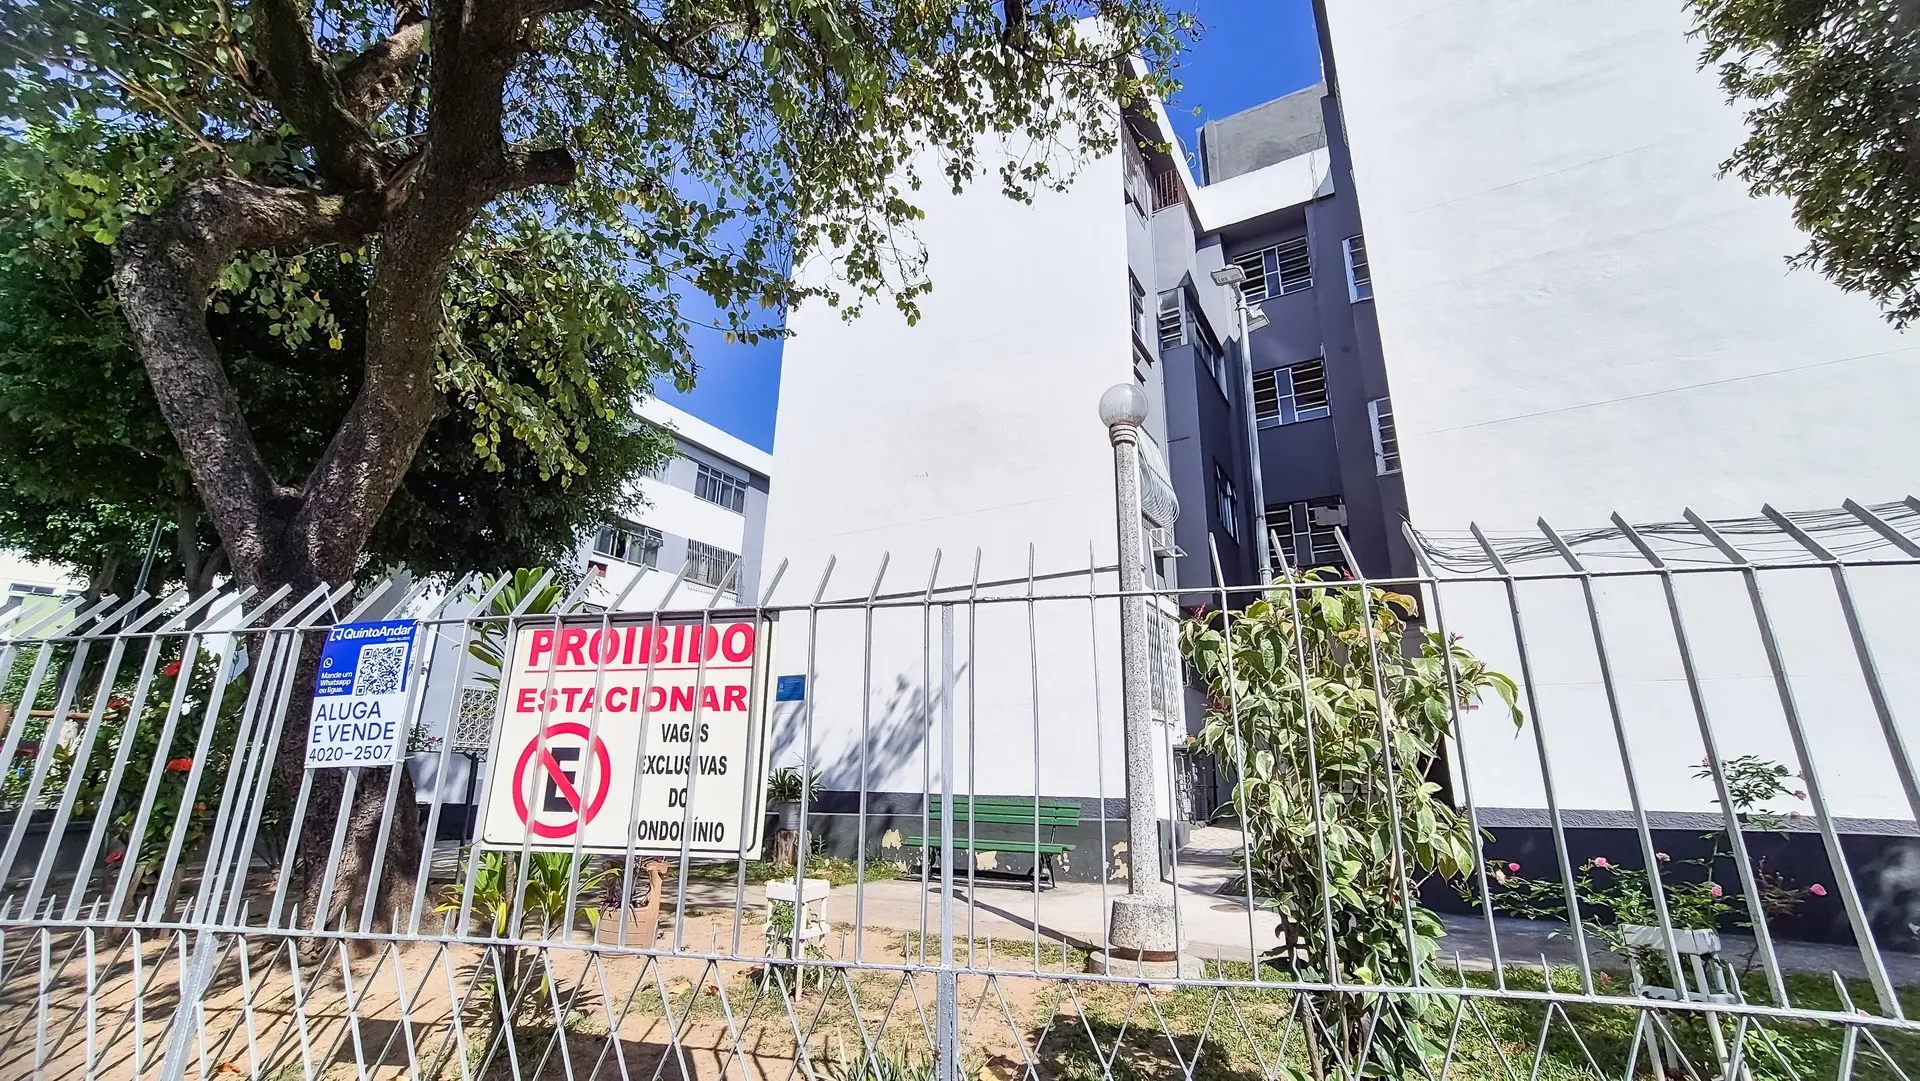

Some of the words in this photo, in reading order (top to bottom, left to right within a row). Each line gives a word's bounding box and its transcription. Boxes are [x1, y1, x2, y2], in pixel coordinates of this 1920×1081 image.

[343, 625, 414, 640] QuintoAndar
[529, 623, 755, 667] PROIBIDO
[320, 679, 351, 687] Whatsapp
[516, 686, 748, 713] ESTACIONAR
[315, 701, 381, 722] ALUGA
[312, 725, 323, 743] E
[328, 721, 396, 743] VENDE
[662, 723, 709, 743] VAGS
[309, 745, 393, 763] 4020-2507
[642, 755, 727, 775] XCLUSVAS
[668, 787, 688, 808] DO
[630, 817, 725, 843] ONDOÍNIO
